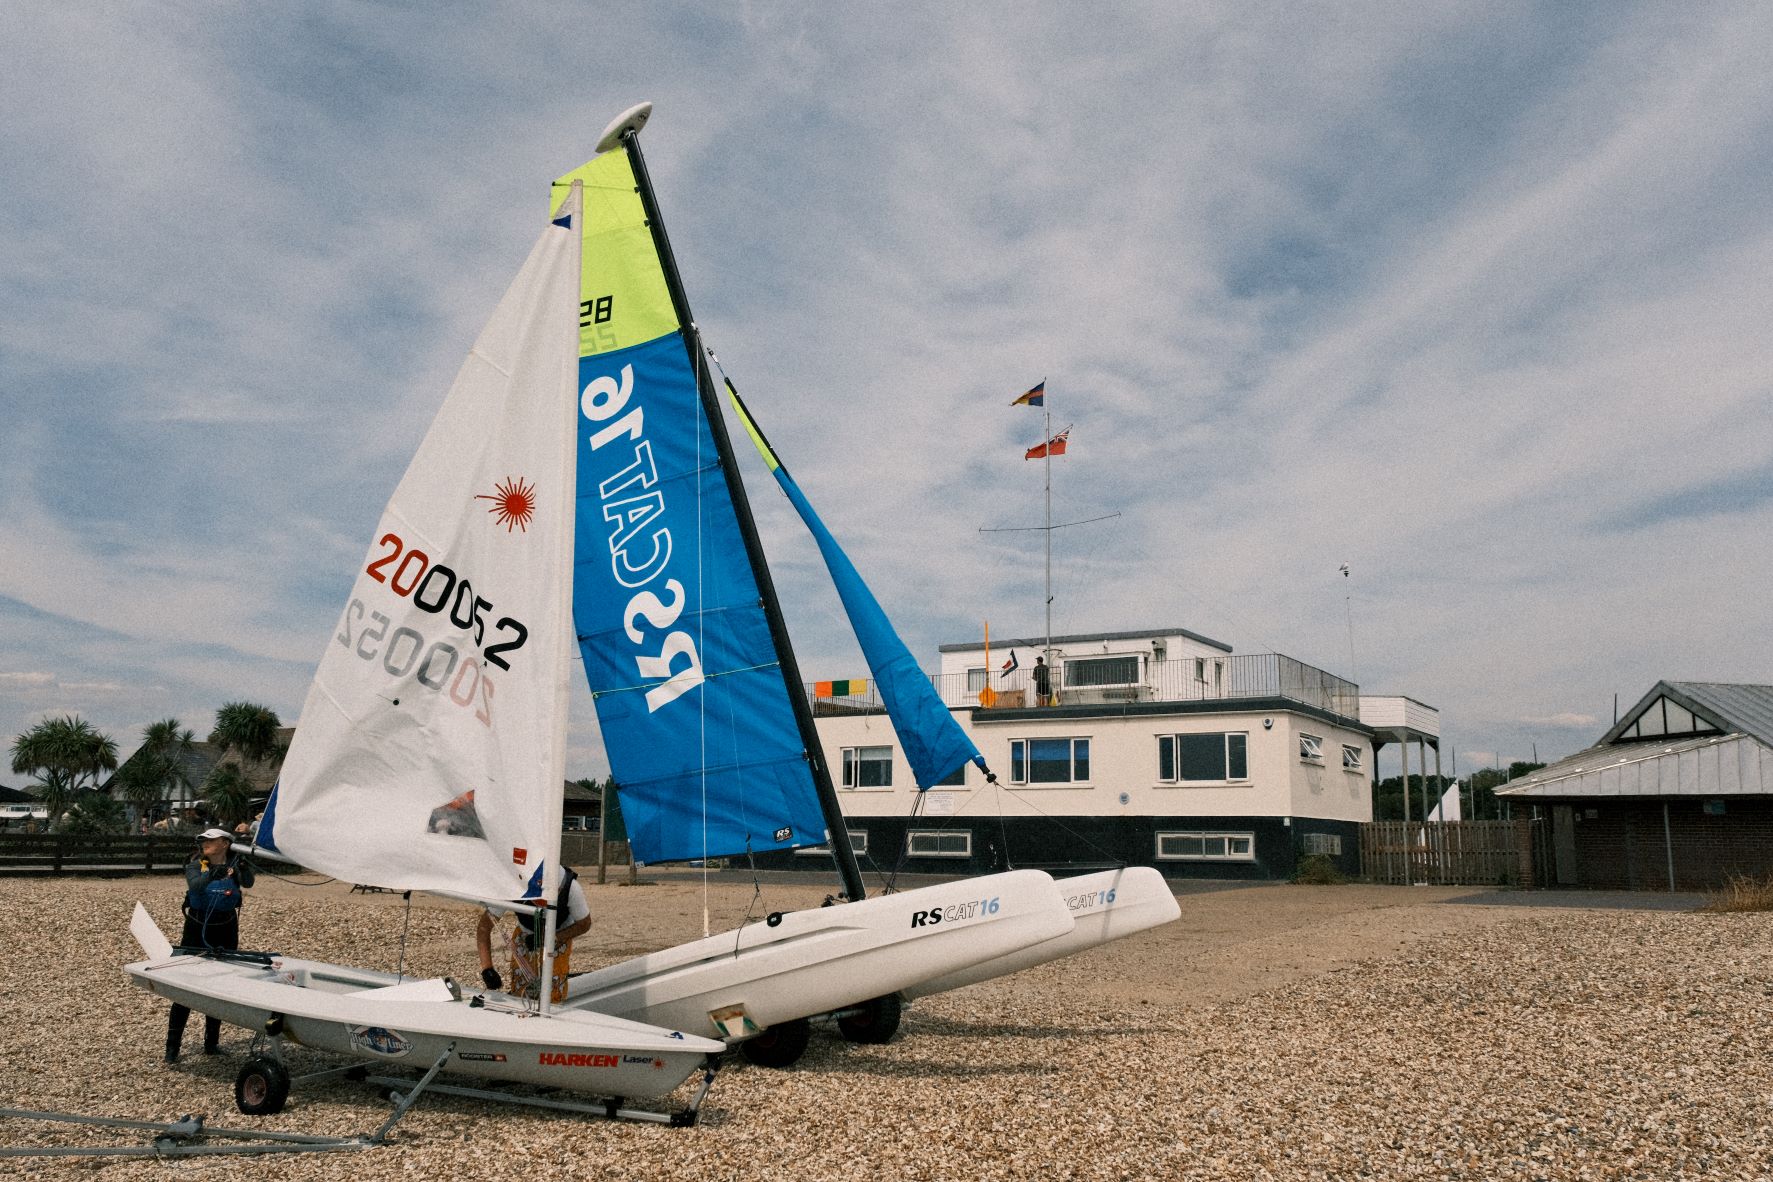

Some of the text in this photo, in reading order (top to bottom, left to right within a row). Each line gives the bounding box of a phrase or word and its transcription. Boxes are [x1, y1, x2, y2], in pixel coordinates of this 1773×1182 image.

[366, 533, 529, 672] 200052
[539, 1052, 653, 1068] HARKEN Laser
